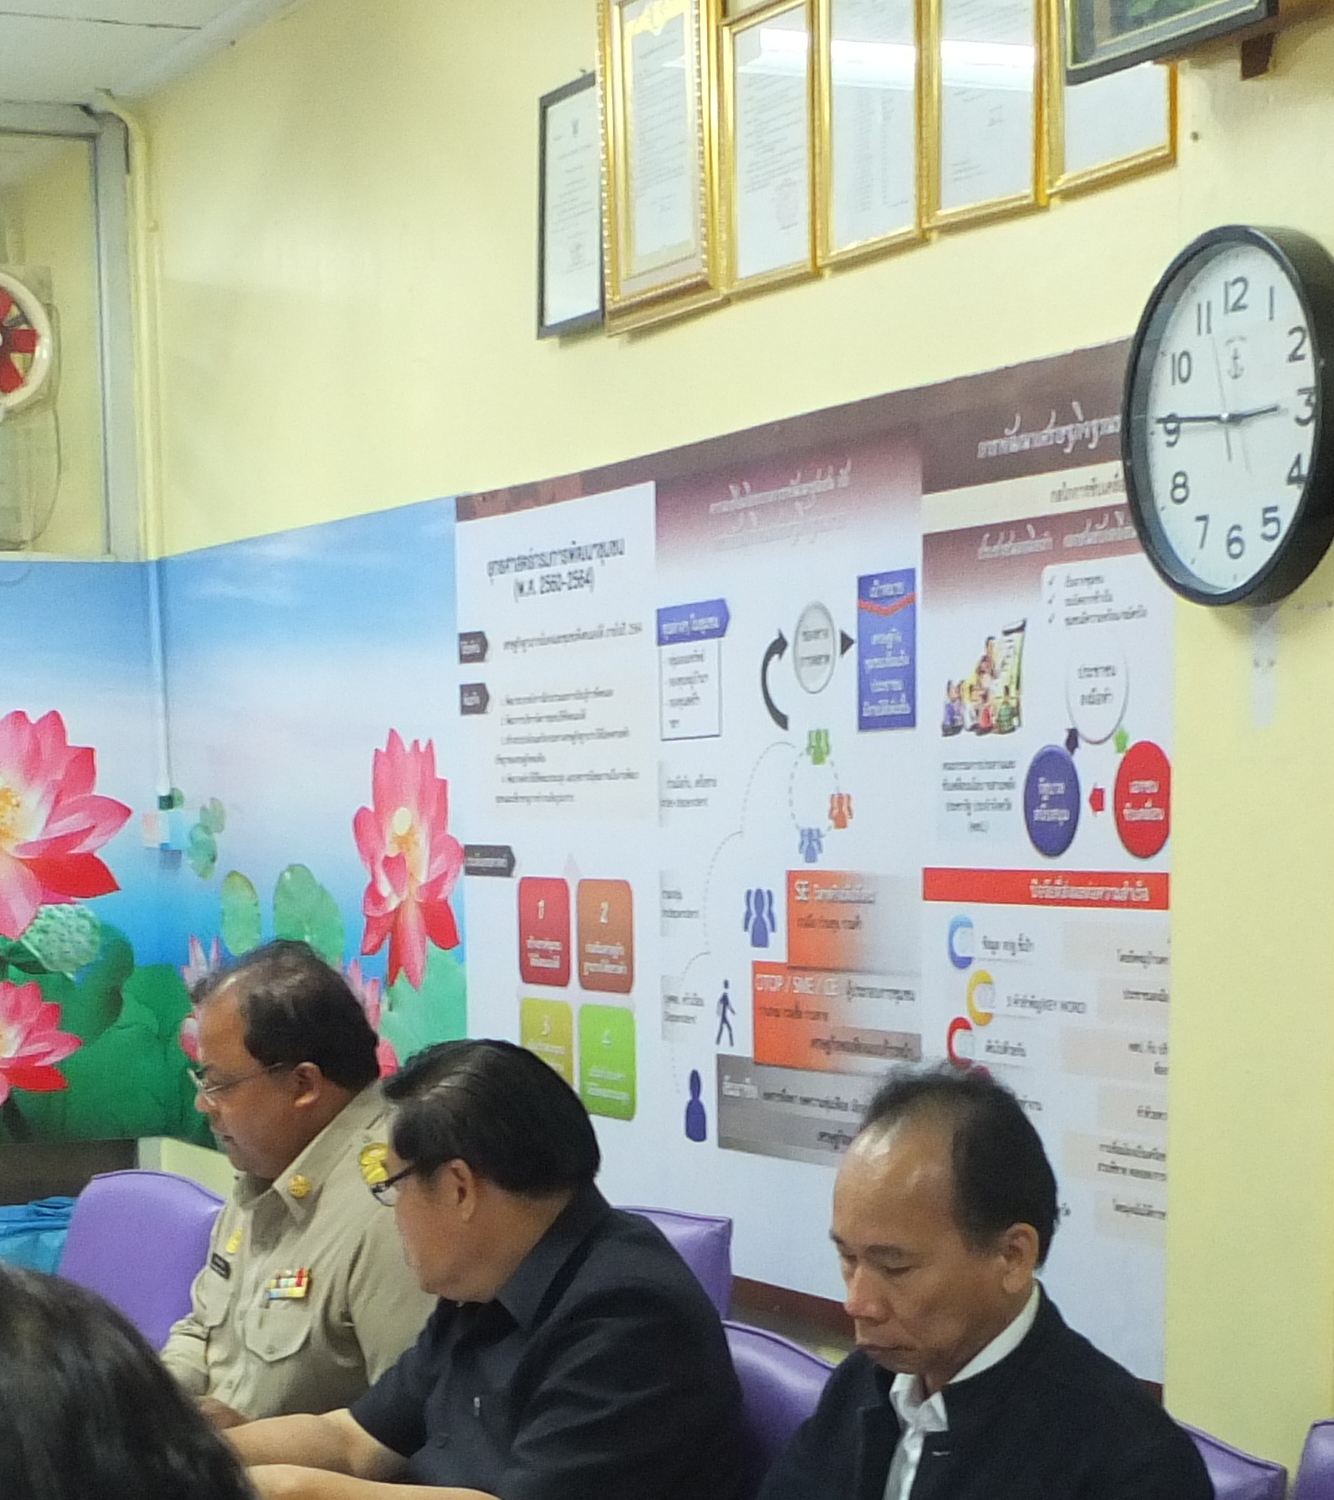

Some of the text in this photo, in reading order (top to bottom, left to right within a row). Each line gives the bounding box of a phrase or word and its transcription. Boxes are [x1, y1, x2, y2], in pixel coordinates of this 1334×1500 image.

[1223, 277, 1249, 314] 12
[1268, 286, 1275, 321] 1
[1196, 301, 1212, 336] 11
[1286, 326, 1307, 363] 2
[1171, 350, 1192, 386] 10
[1294, 386, 1316, 426] 3
[1163, 413, 1181, 448] 9
[1286, 452, 1308, 487] 4
[1170, 471, 1189, 505] 8
[1194, 514, 1210, 549] 7
[1260, 506, 1281, 541] 5
[1225, 524, 1245, 559] 6
